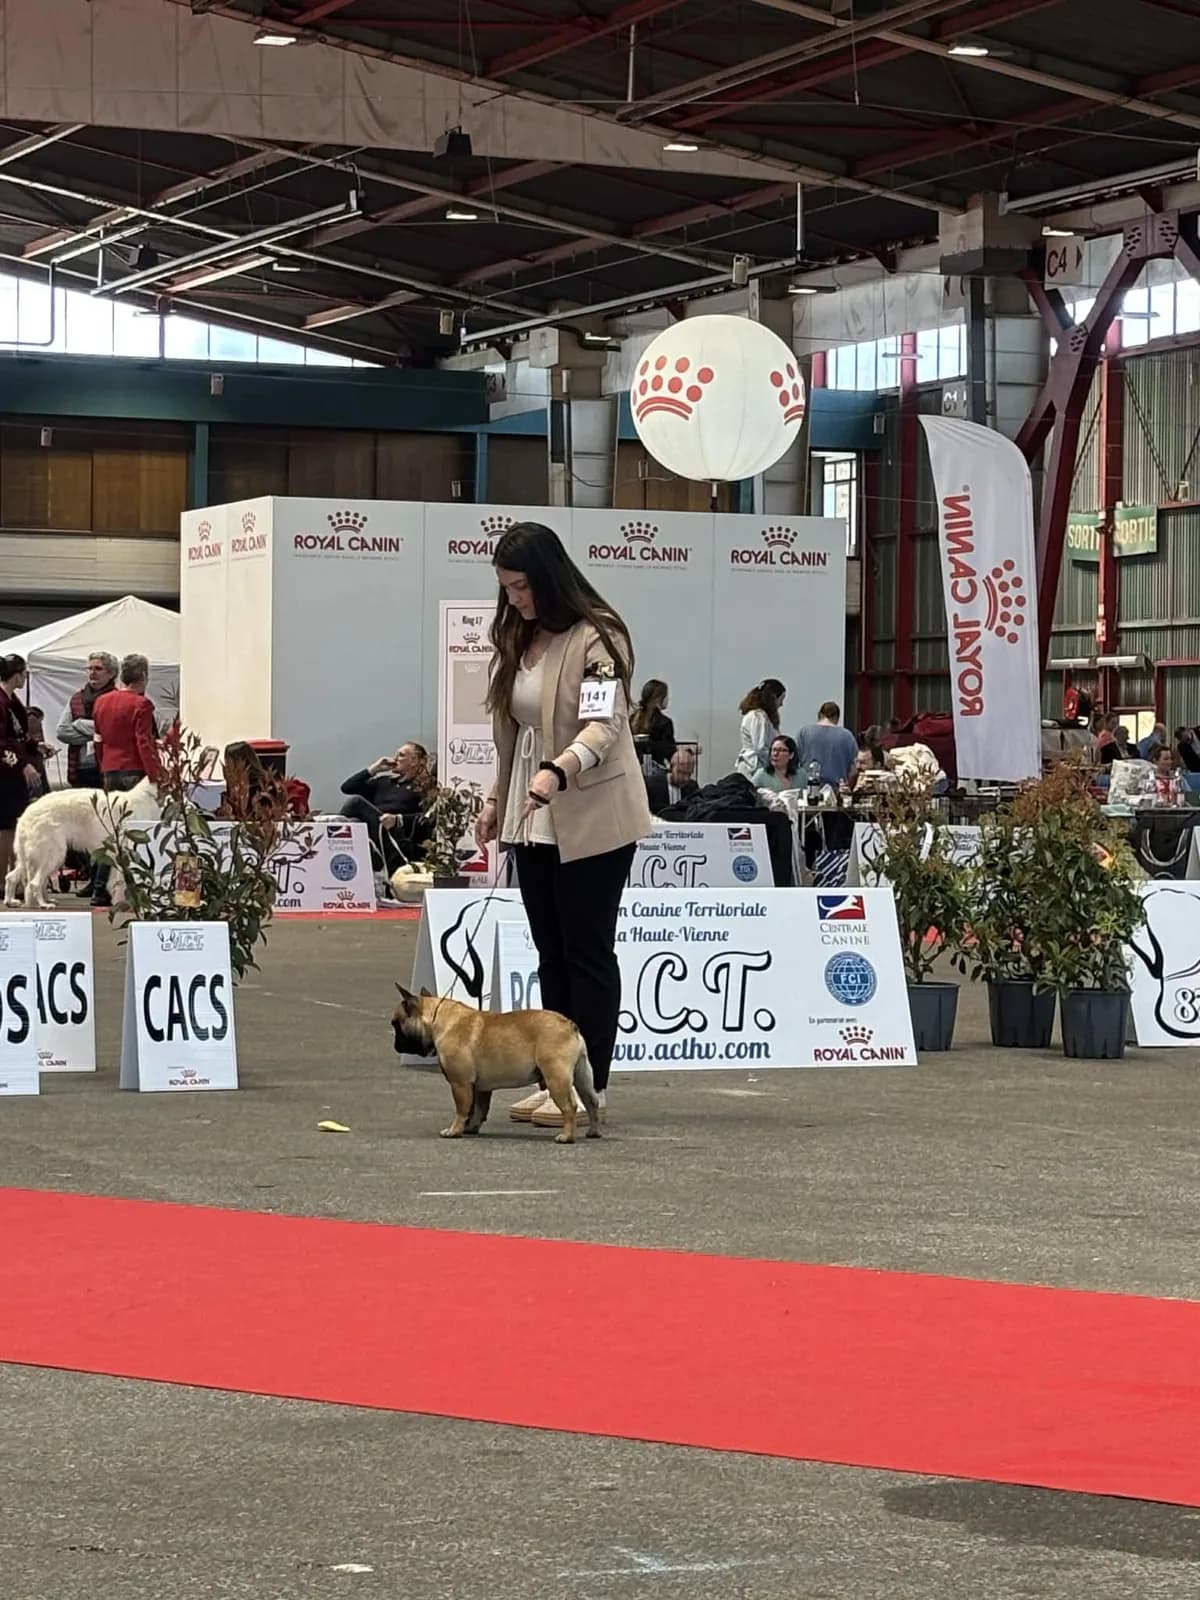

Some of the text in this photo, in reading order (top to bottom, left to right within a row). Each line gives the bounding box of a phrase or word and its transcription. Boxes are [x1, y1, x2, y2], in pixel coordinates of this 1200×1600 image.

[1047, 249, 1067, 278] C4
[294, 535, 400, 552] ROYAL CANIN
[1067, 524, 1100, 551] SORTI
[448, 540, 494, 555] ROYAL
[588, 544, 689, 562] ROYAL CANIN
[730, 550, 827, 567] ROYAL CANIN
[581, 690, 606, 704] 1141
[664, 830, 704, 840] Territoriale
[617, 901, 768, 918] n Canine Territoriale
[615, 926, 730, 943] a Haute-Vienne
[820, 923, 868, 934] CENTRALE
[821, 935, 870, 945] CANINE
[840, 973, 861, 984] FCI
[618, 950, 776, 1035] .C.T.
[0, 974, 30, 1044] S
[143, 974, 228, 1042] CACS
[611, 1037, 771, 1061] ww.acthv.com
[814, 1047, 905, 1062] ROYAL CANIN
